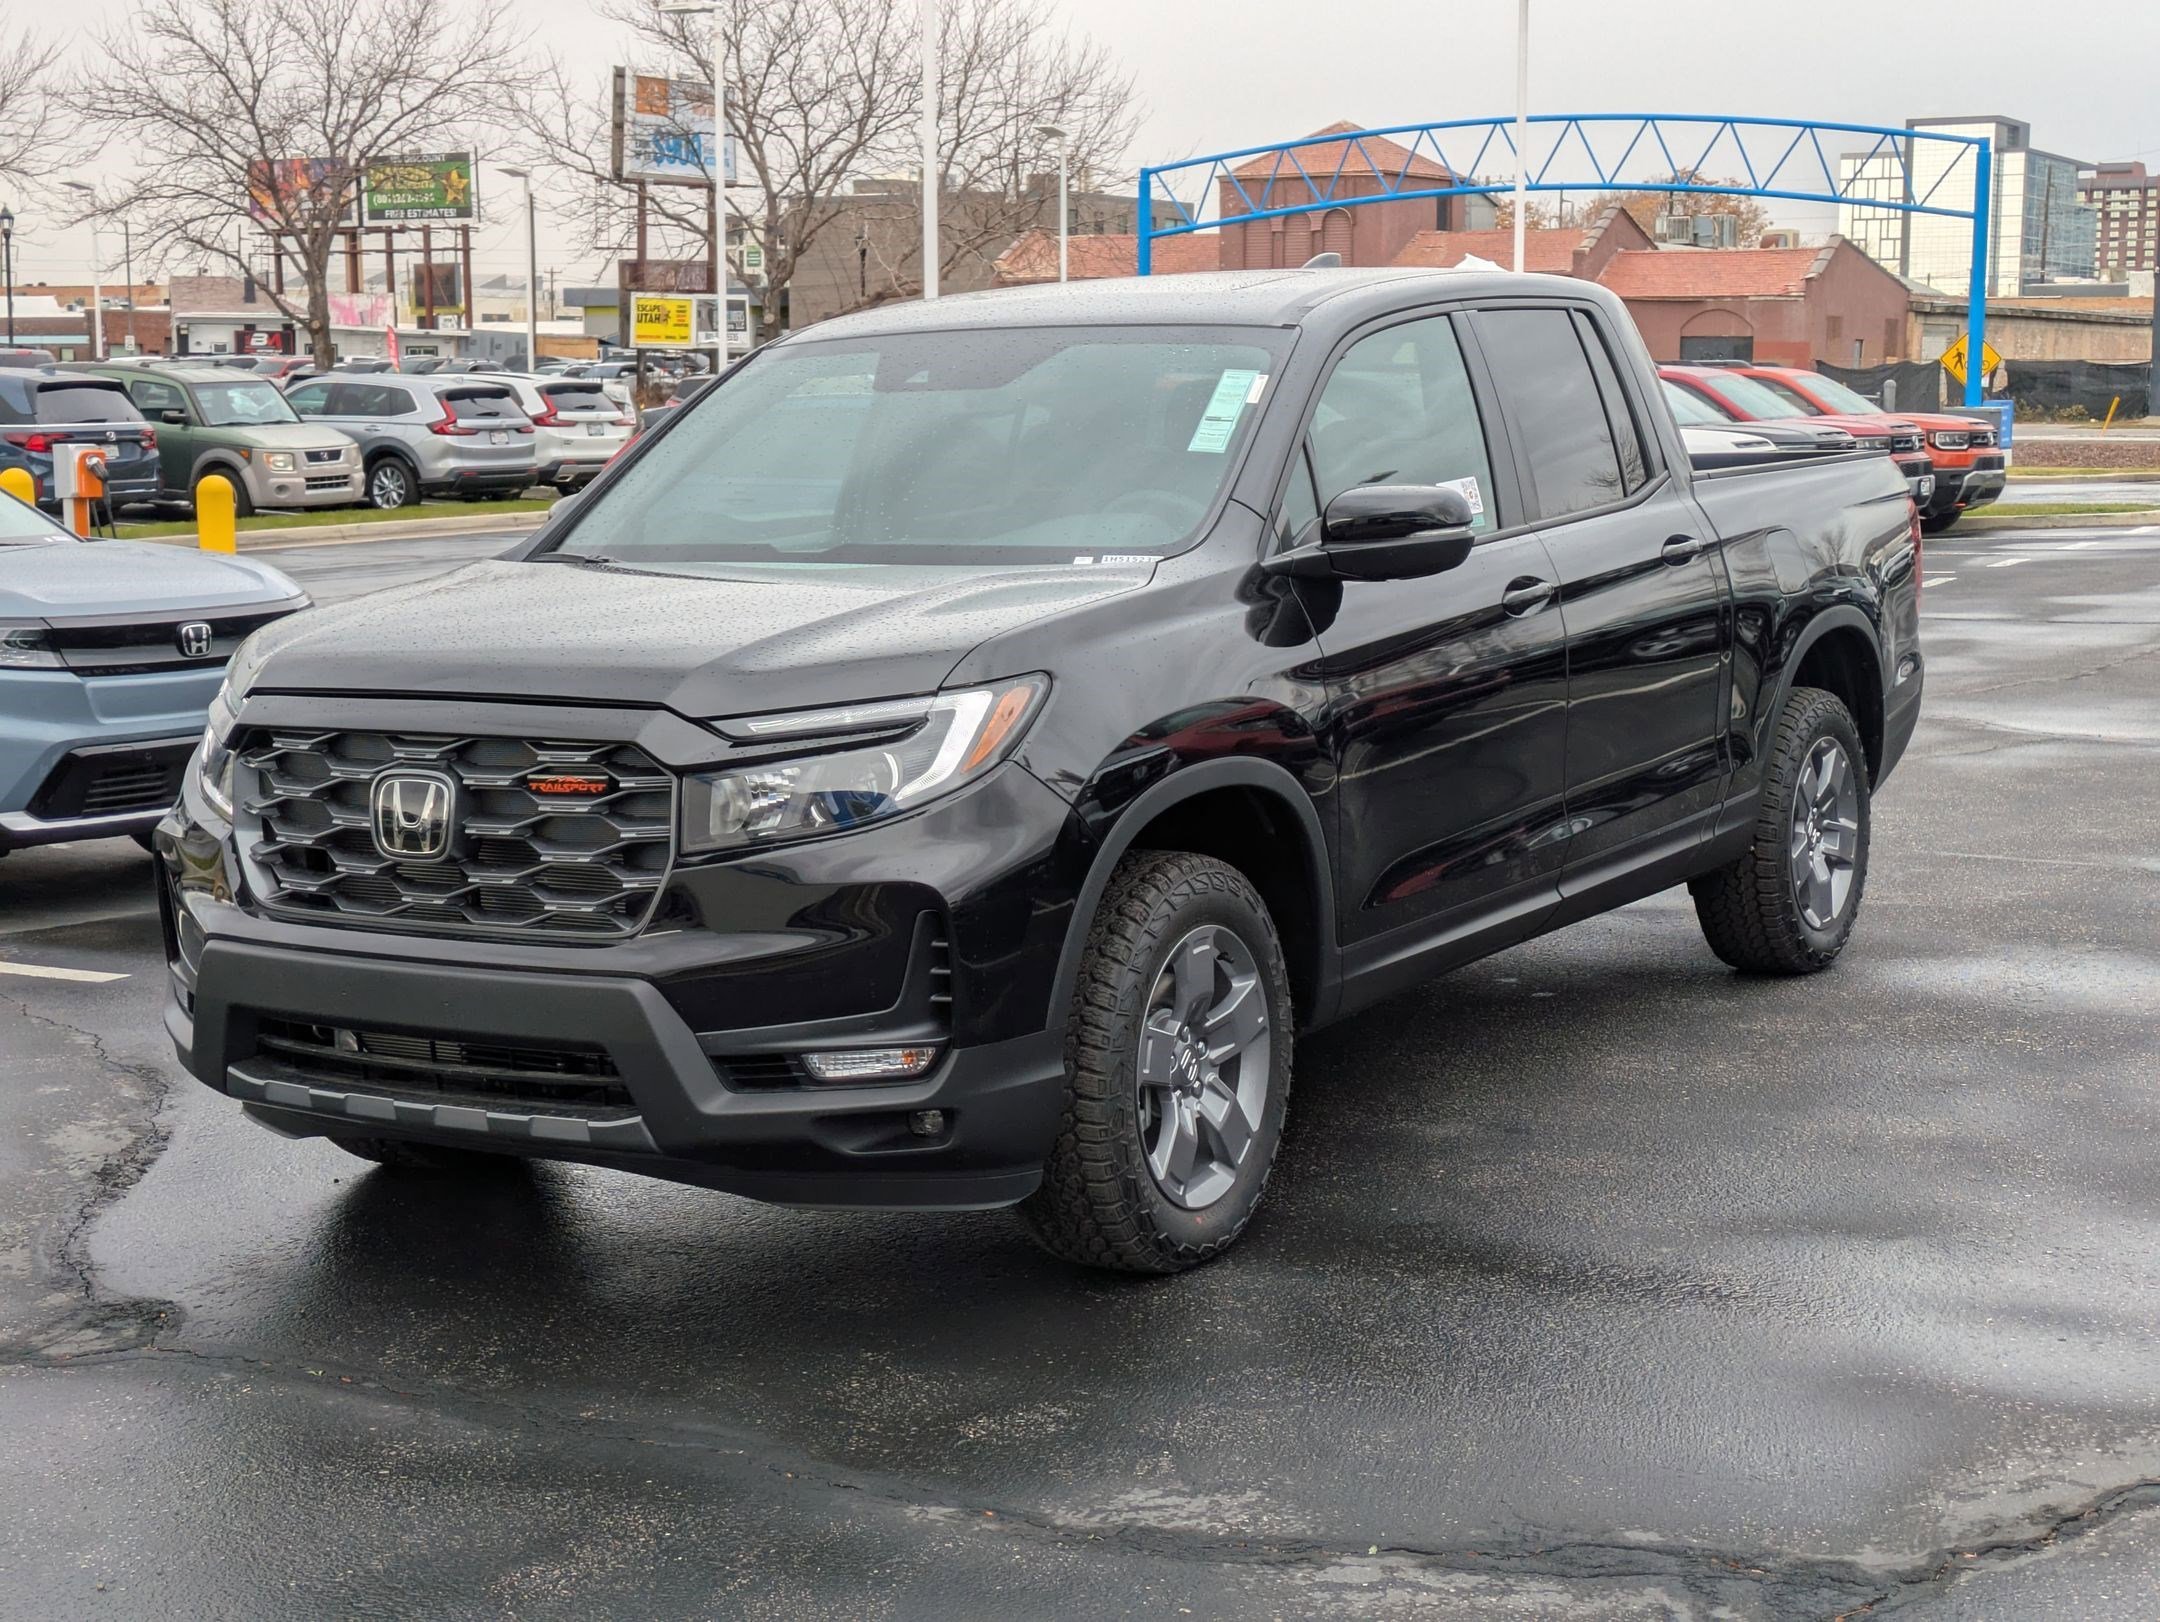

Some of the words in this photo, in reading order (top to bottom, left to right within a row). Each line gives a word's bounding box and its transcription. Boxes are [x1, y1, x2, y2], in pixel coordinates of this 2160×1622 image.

[636, 304, 661, 312] ESCAPE
[636, 312, 661, 323] UTAH
[529, 782, 607, 793] TRAILSPORT
